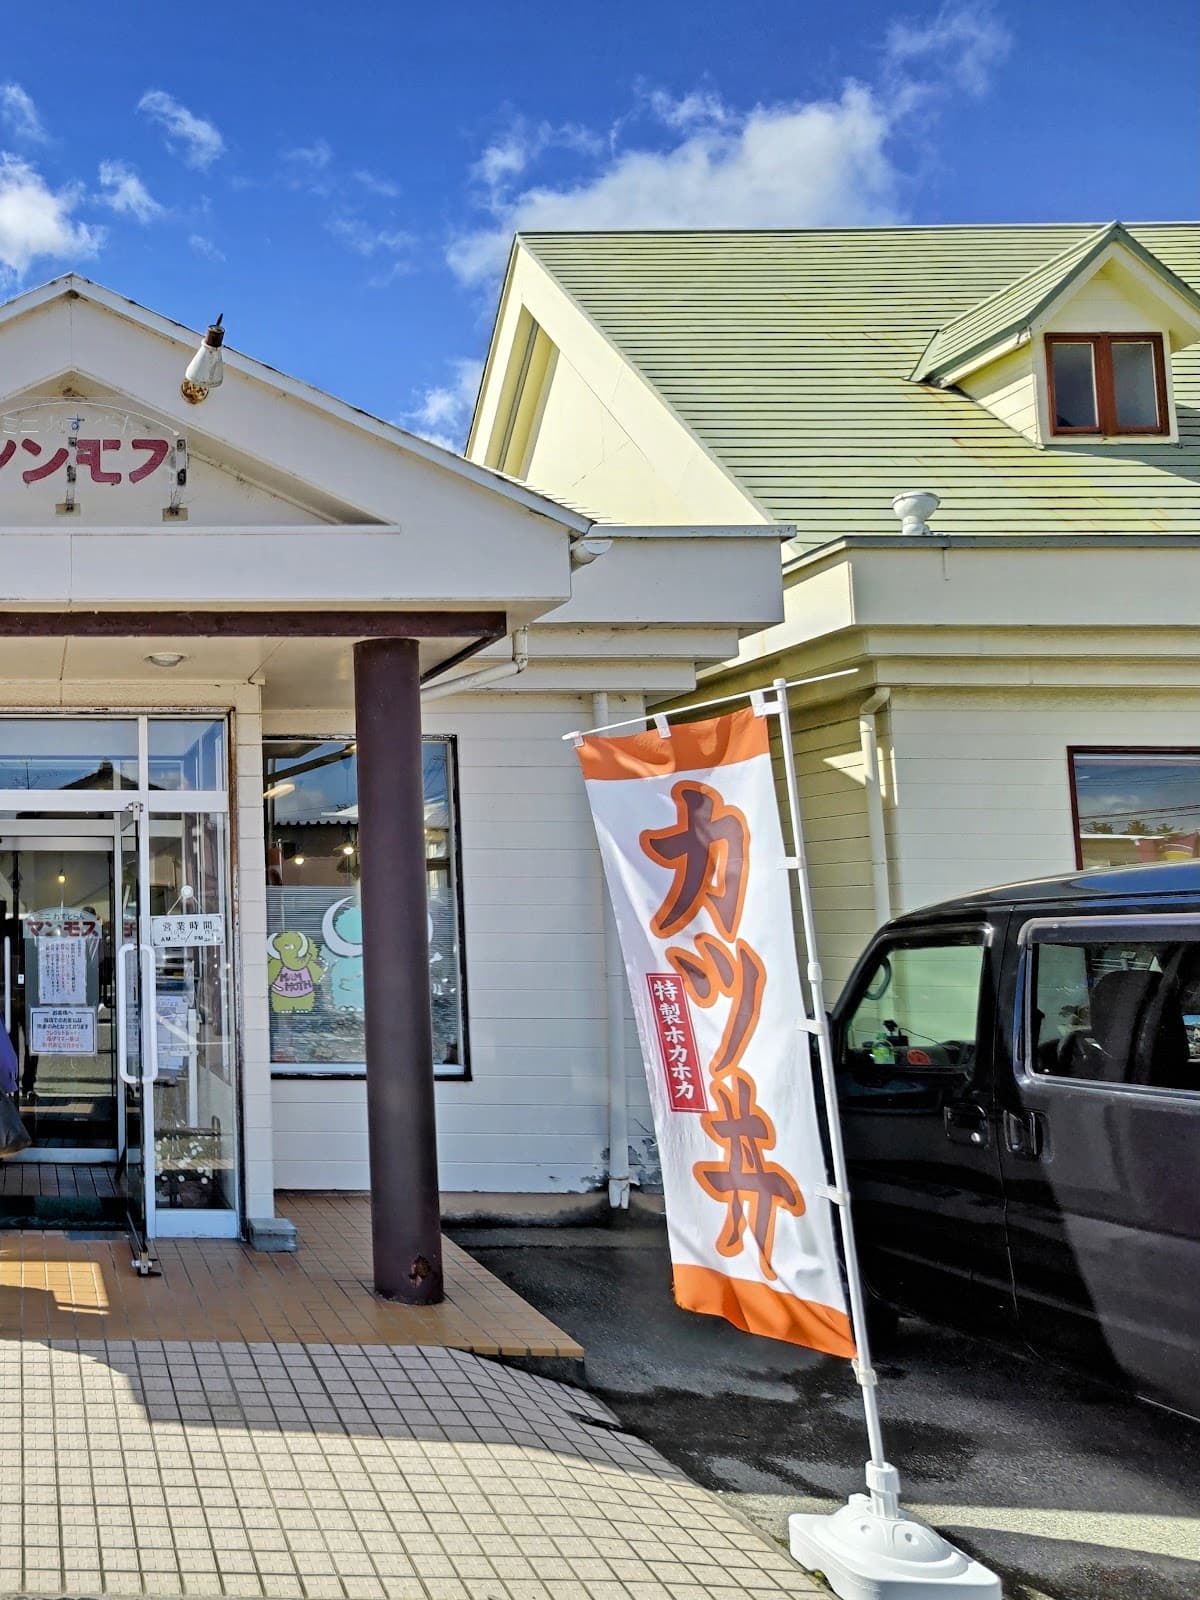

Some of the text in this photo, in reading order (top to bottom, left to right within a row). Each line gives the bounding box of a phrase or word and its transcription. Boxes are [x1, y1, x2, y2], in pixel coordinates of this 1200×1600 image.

[27, 921, 98, 936] マンモス
[653, 980, 695, 1100] 特製ホカホカ
